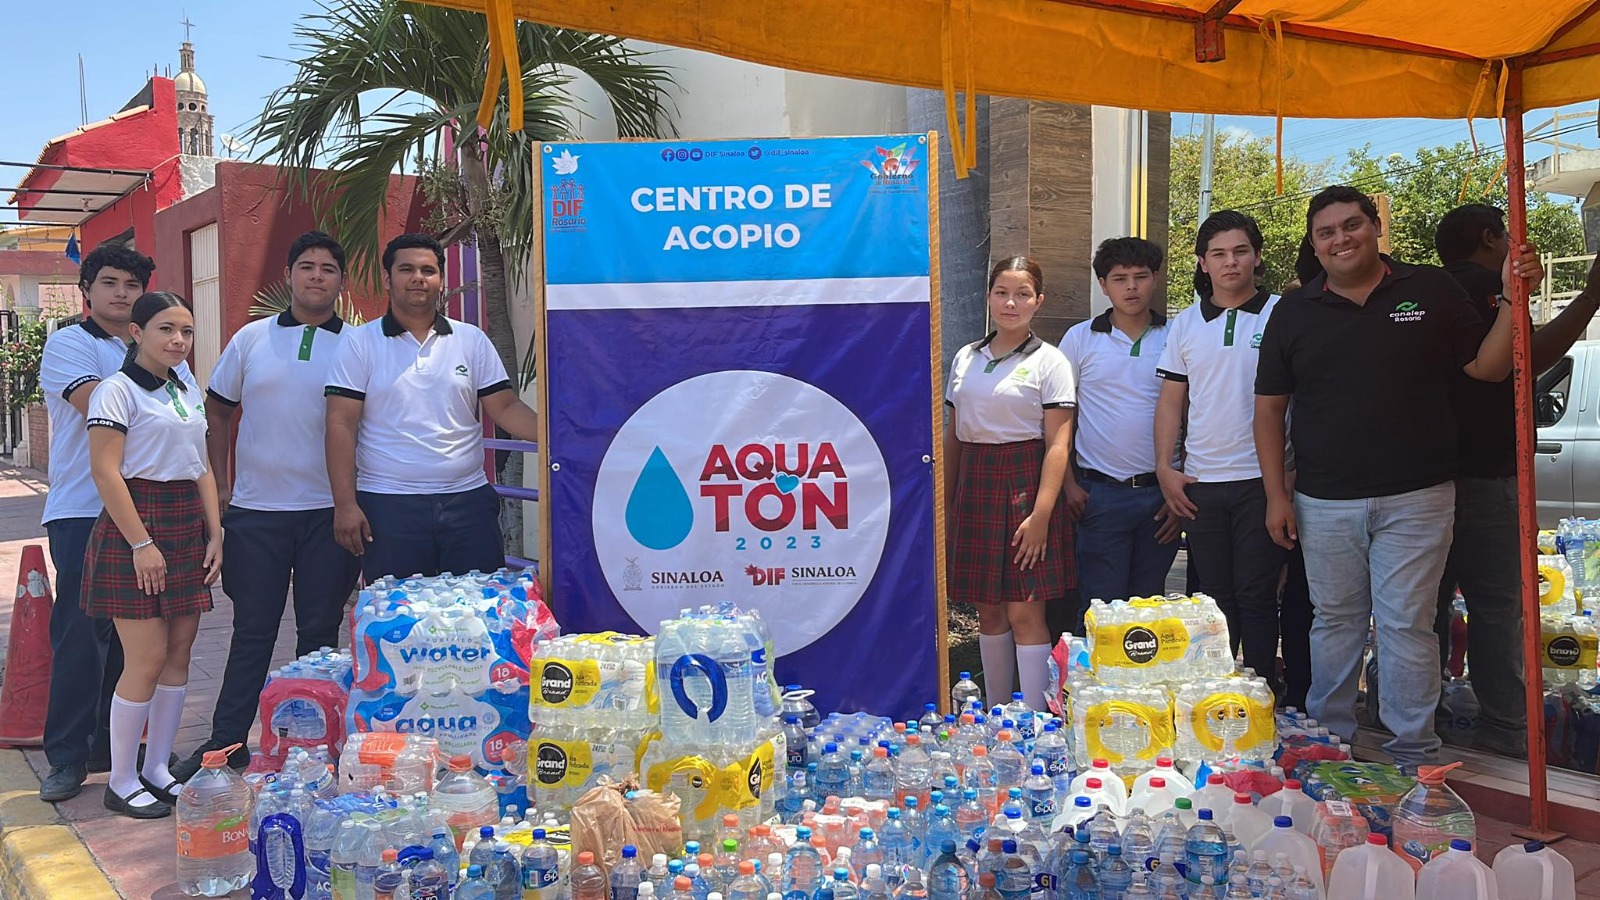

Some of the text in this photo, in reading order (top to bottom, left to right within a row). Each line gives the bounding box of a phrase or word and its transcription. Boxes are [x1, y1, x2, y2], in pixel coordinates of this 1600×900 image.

[631, 183, 832, 213] CENTRO DE
[552, 199, 584, 216] DIF
[552, 216, 586, 226] Rosario
[662, 222, 801, 250] ACOPIO
[1394, 315, 1422, 323] Rosario
[699, 442, 848, 482] AQUA
[700, 481, 849, 533] TON
[735, 535, 821, 550] 2023
[651, 570, 724, 584] SINALOA
[752, 567, 786, 586] DIF
[791, 566, 857, 578] SINALOA
[1124, 638, 1157, 651] Grand
[400, 644, 491, 664] water
[495, 667, 511, 678] 18
[395, 715, 478, 737] agua
[489, 738, 503, 751] 18
[1041, 875, 1049, 886] 6
